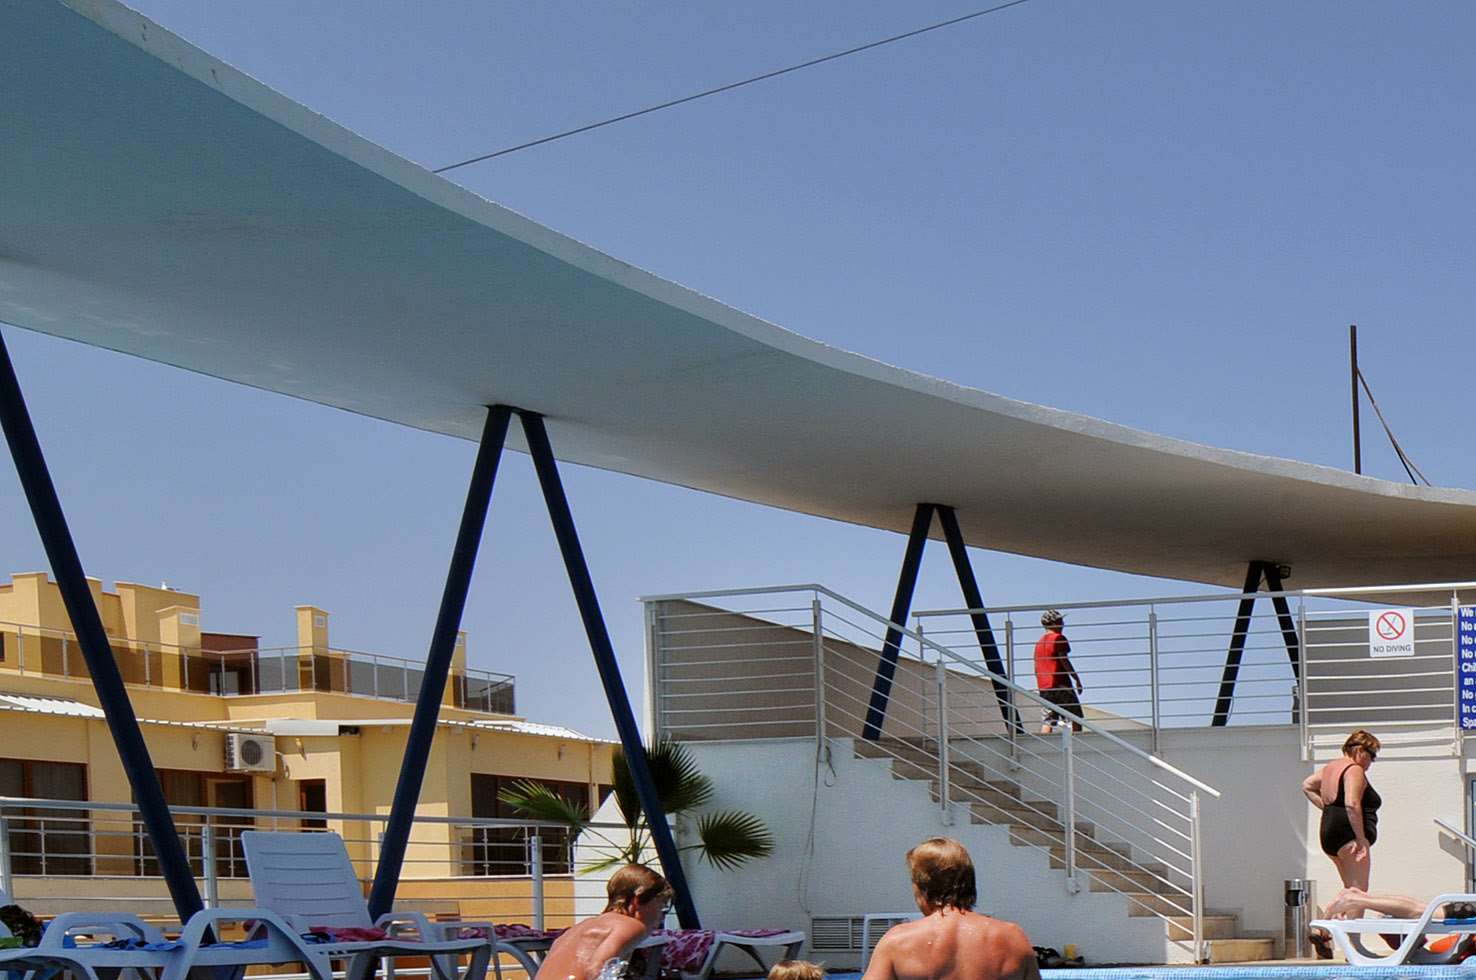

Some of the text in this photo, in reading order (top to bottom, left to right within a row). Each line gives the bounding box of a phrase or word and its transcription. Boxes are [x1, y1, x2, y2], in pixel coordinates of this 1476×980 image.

[1461, 607, 1473, 617] We
[1461, 620, 1472, 629] No
[1461, 635, 1472, 644] No
[1462, 648, 1472, 657] No
[1464, 677, 1473, 685] an
[1462, 689, 1473, 698] No
[1462, 703, 1469, 712] In
[1462, 717, 1476, 728] Spa
